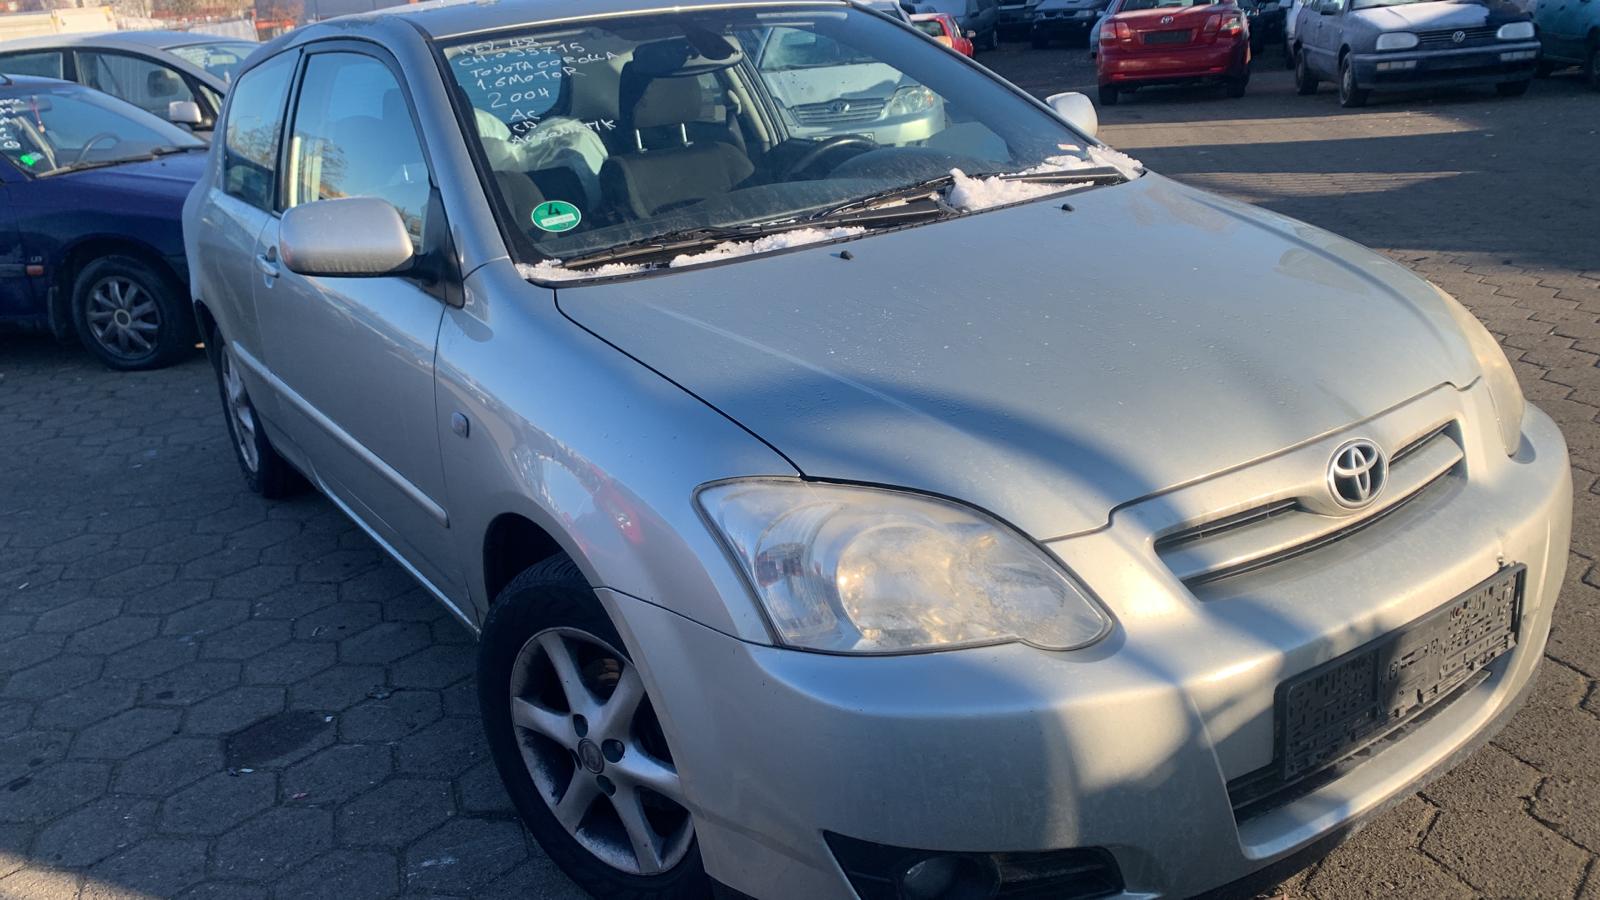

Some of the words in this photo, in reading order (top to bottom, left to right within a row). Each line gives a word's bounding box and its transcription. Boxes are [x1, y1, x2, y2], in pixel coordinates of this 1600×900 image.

[537, 51, 619, 69] COROLLA
[487, 87, 550, 109] 2004
[547, 203, 561, 216] 4
